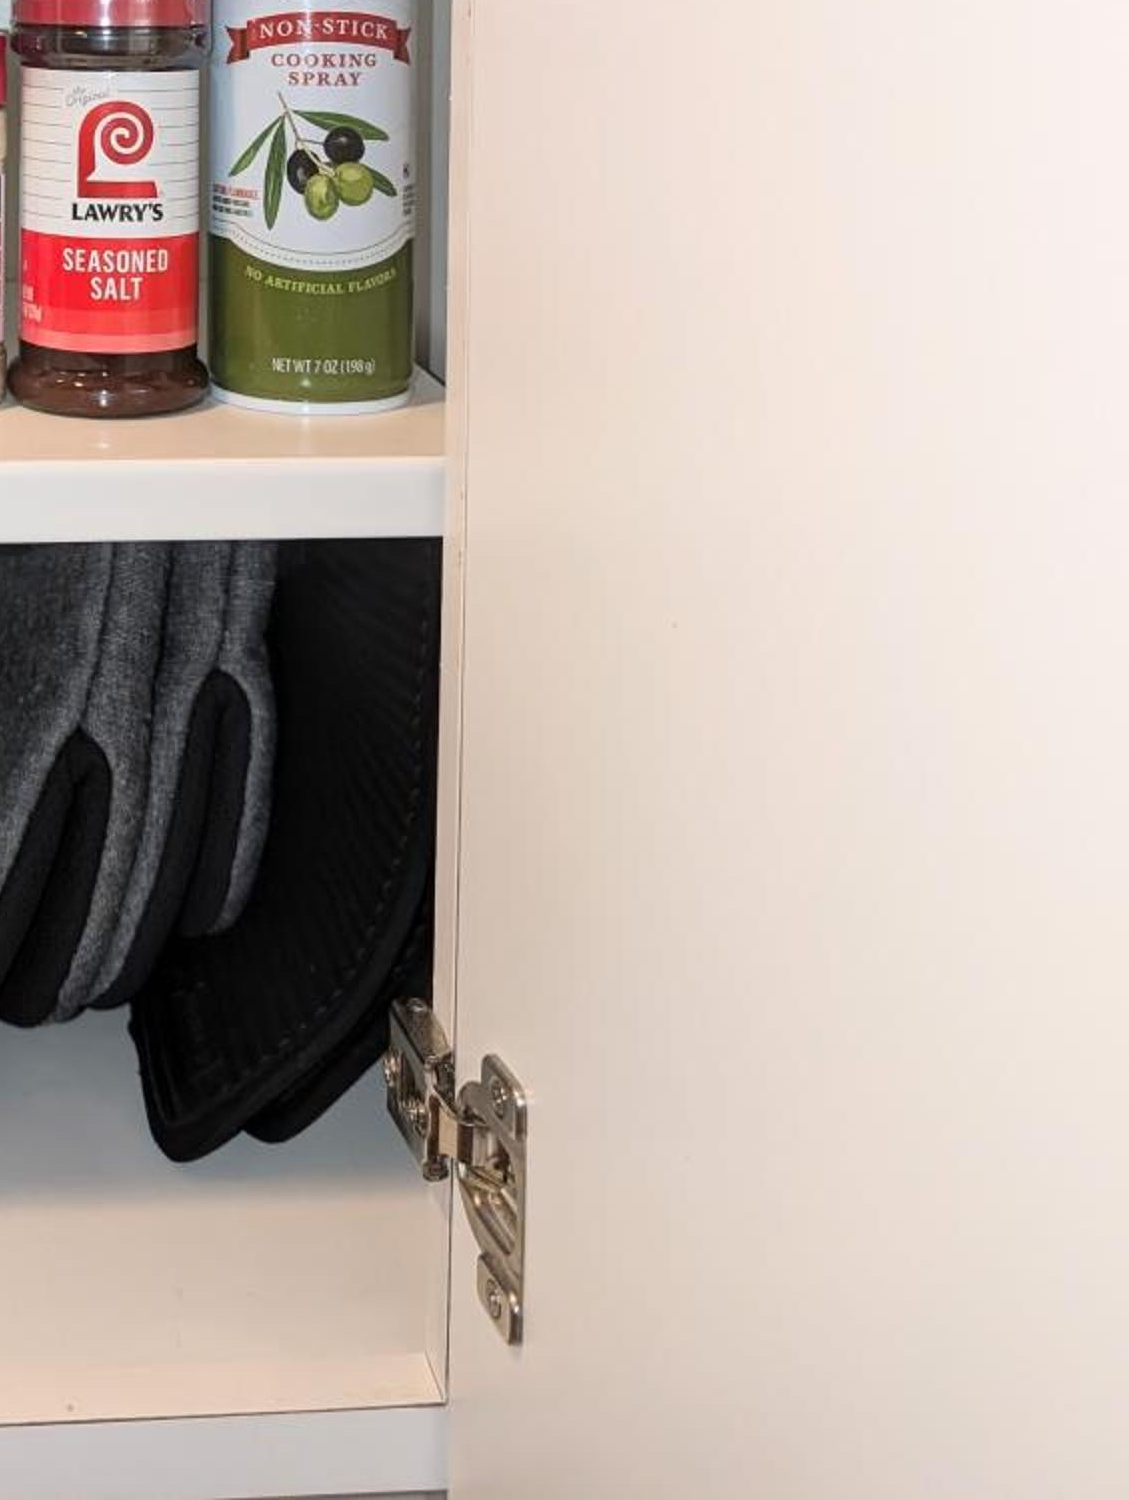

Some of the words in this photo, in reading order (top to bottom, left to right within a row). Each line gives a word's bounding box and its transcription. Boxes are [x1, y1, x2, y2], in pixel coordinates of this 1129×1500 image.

[259, 17, 388, 40] NON-STICK
[270, 52, 377, 68] COOKING
[288, 71, 362, 87] SPRAY
[72, 203, 164, 222] LAWRY'S
[62, 247, 168, 274] SEASONED
[89, 276, 144, 301] SALT
[245, 265, 262, 281] NO
[265, 275, 344, 295] ARTIFICIAL
[271, 357, 290, 373] NET
[292, 358, 311, 373] WT
[314, 359, 321, 373] 7
[323, 358, 338, 374] OZ
